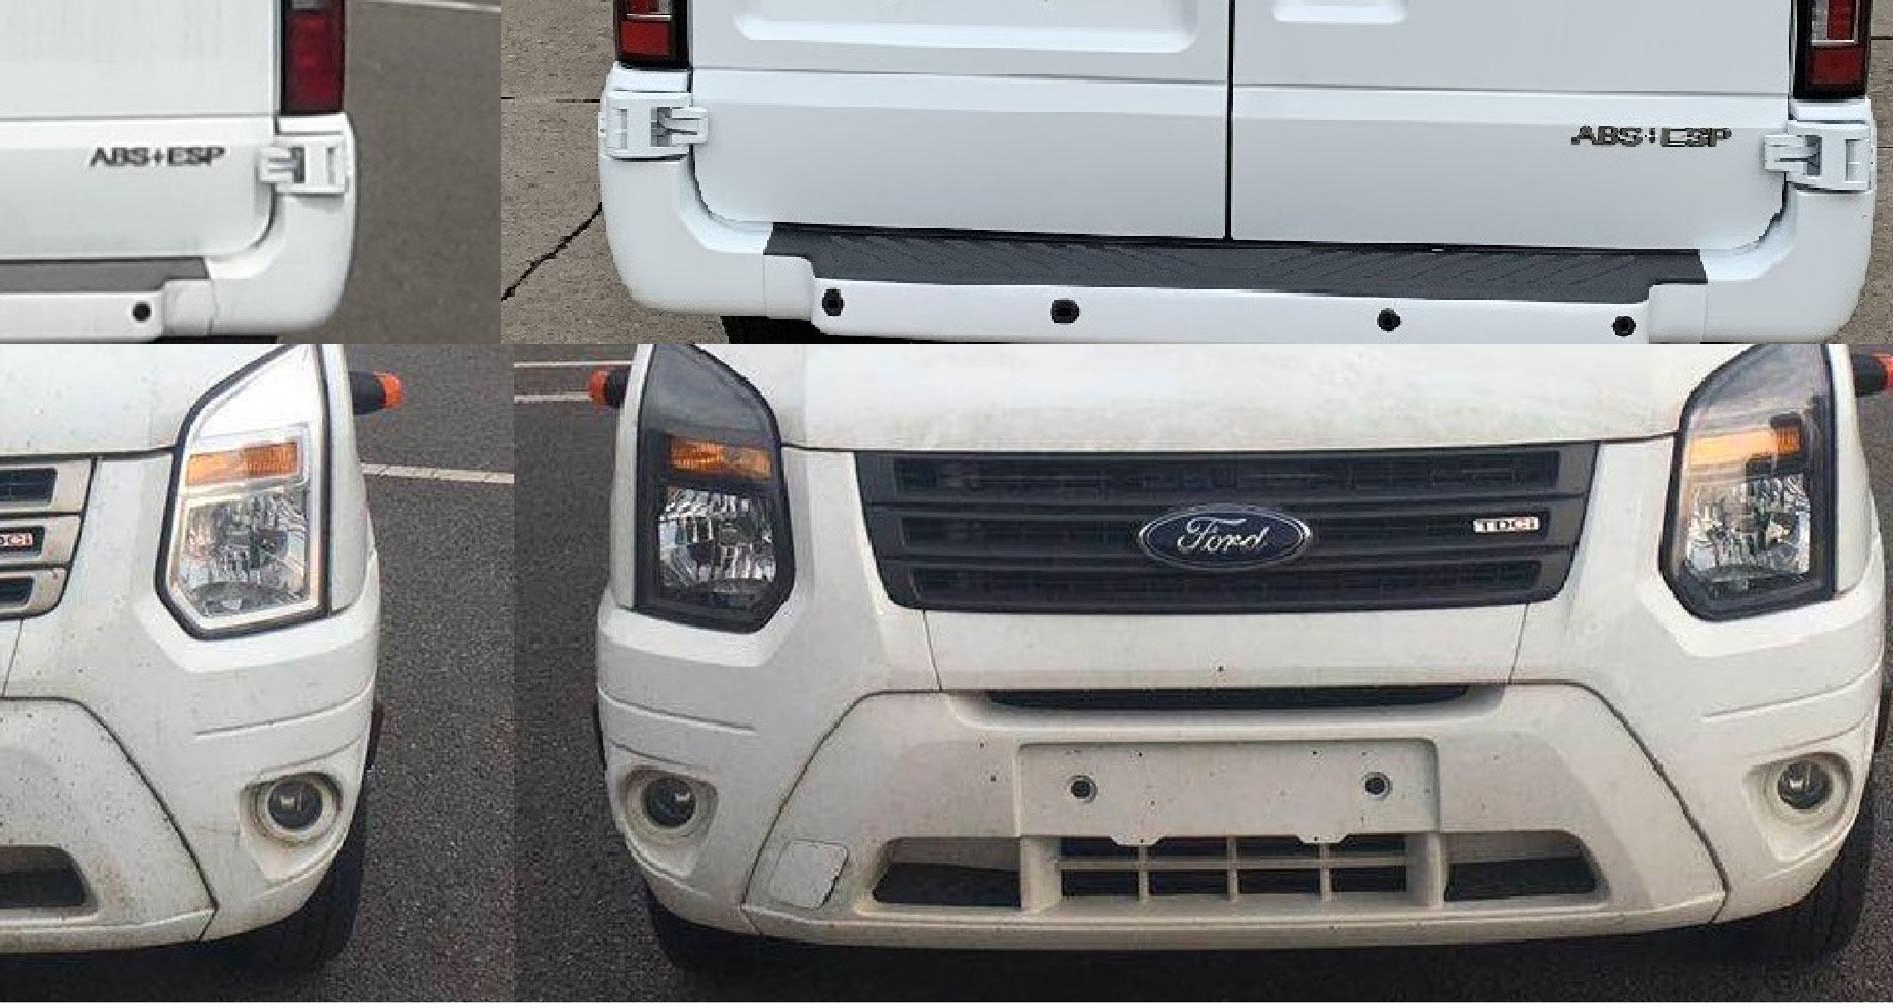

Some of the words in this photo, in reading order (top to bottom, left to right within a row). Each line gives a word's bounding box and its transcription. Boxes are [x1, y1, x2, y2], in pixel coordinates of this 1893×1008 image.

[1570, 125, 1733, 148] ABS+ESP
[88, 146, 227, 168] ABS+ESP
[1177, 515, 1269, 553] Ford
